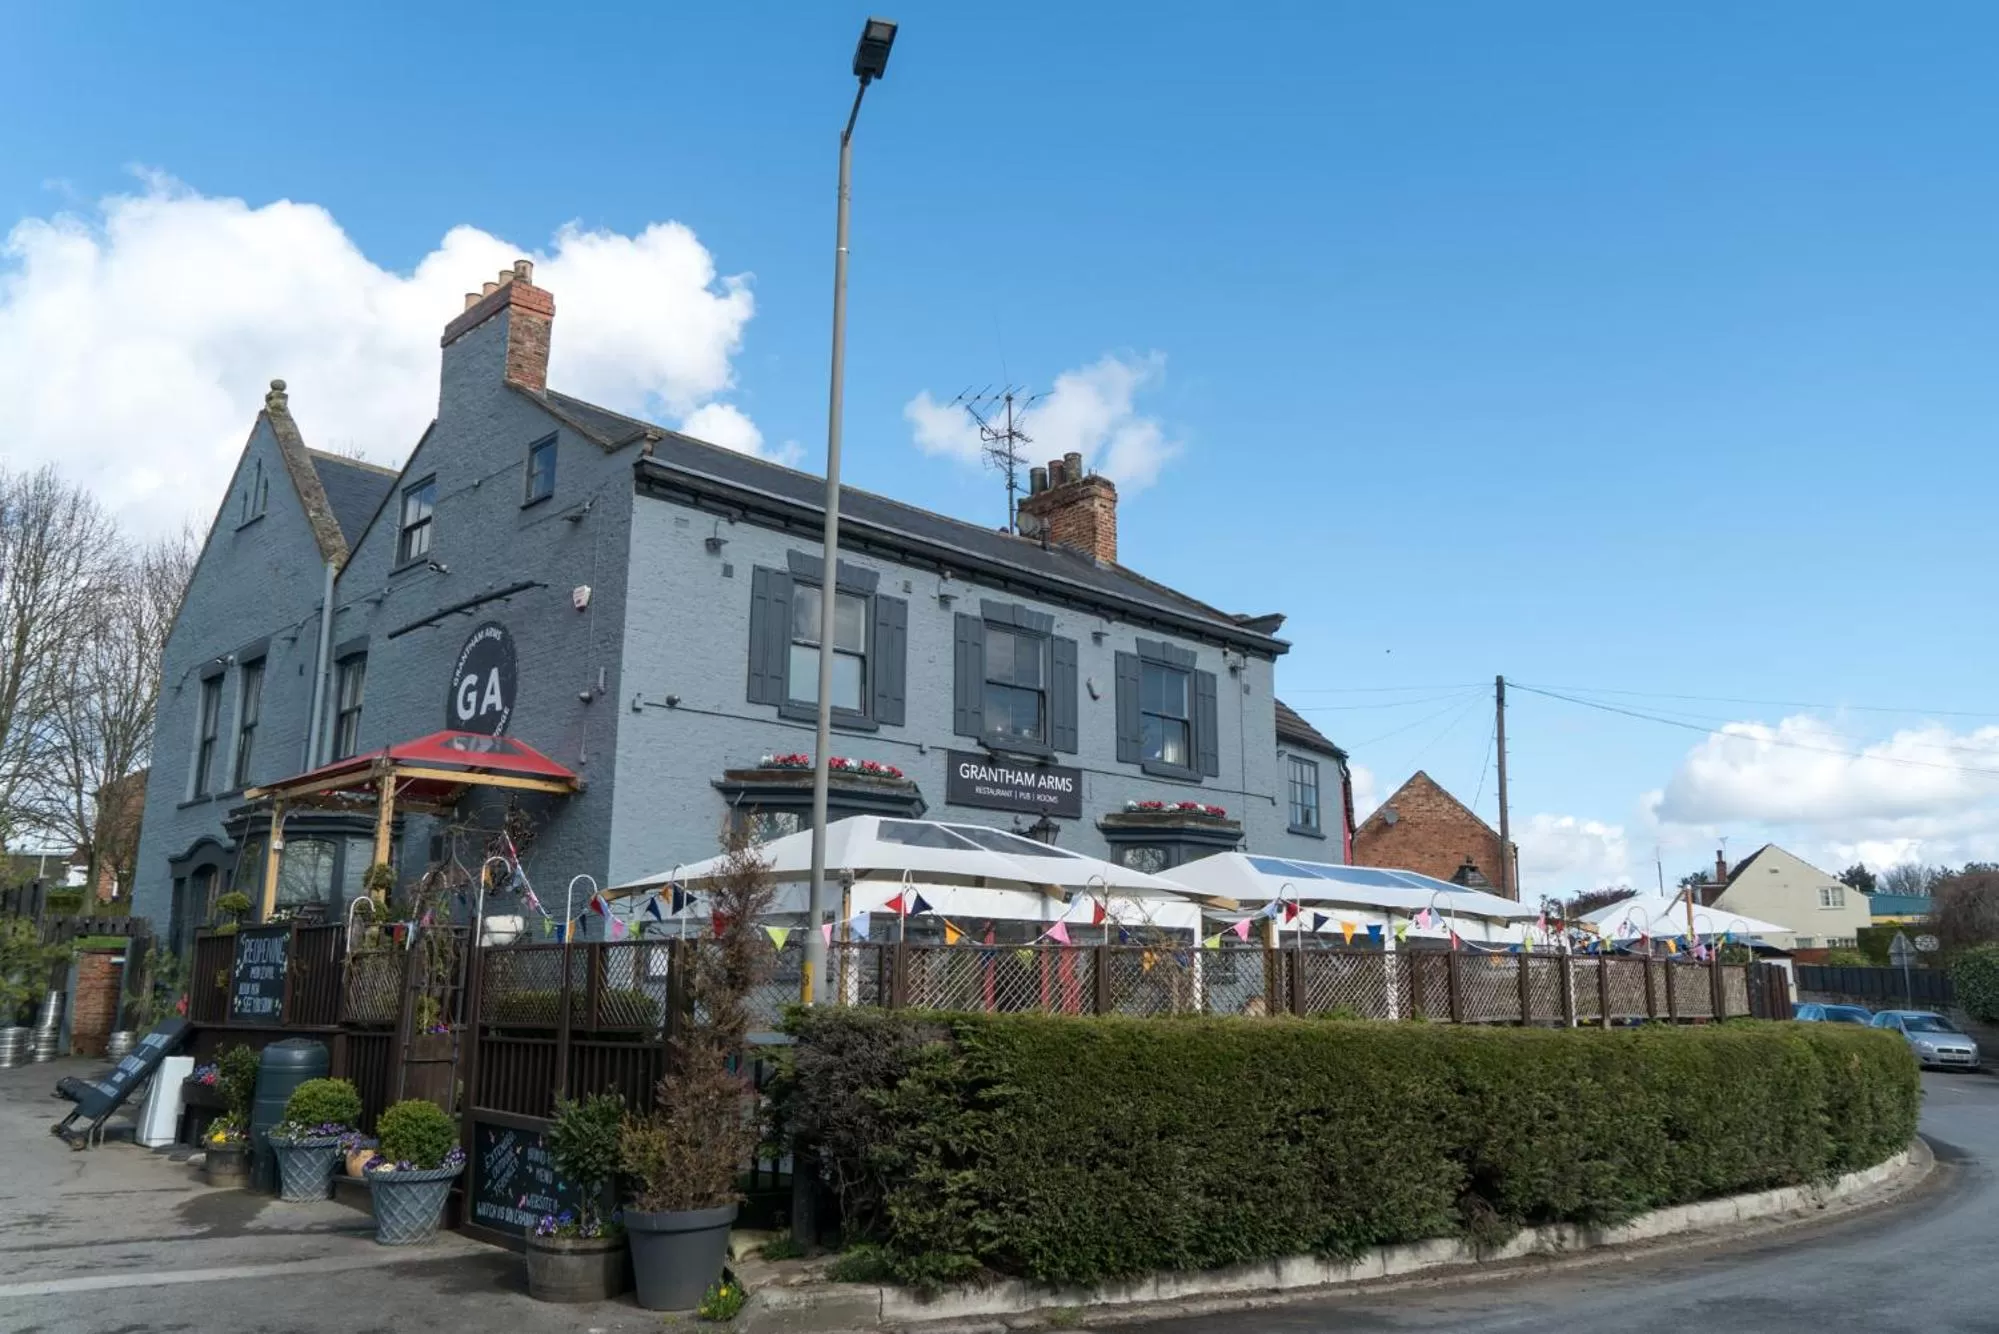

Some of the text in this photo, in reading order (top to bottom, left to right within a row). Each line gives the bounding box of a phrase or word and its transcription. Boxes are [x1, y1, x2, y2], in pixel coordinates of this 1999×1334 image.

[453, 630, 485, 687] GRANTHAM
[457, 666, 503, 721] GA
[959, 762, 1073, 793] GRANTHAM ARMS
[975, 785, 1013, 797] RESTAURANT
[1019, 791, 1031, 801] PUB
[1036, 795, 1059, 804] ROOMS
